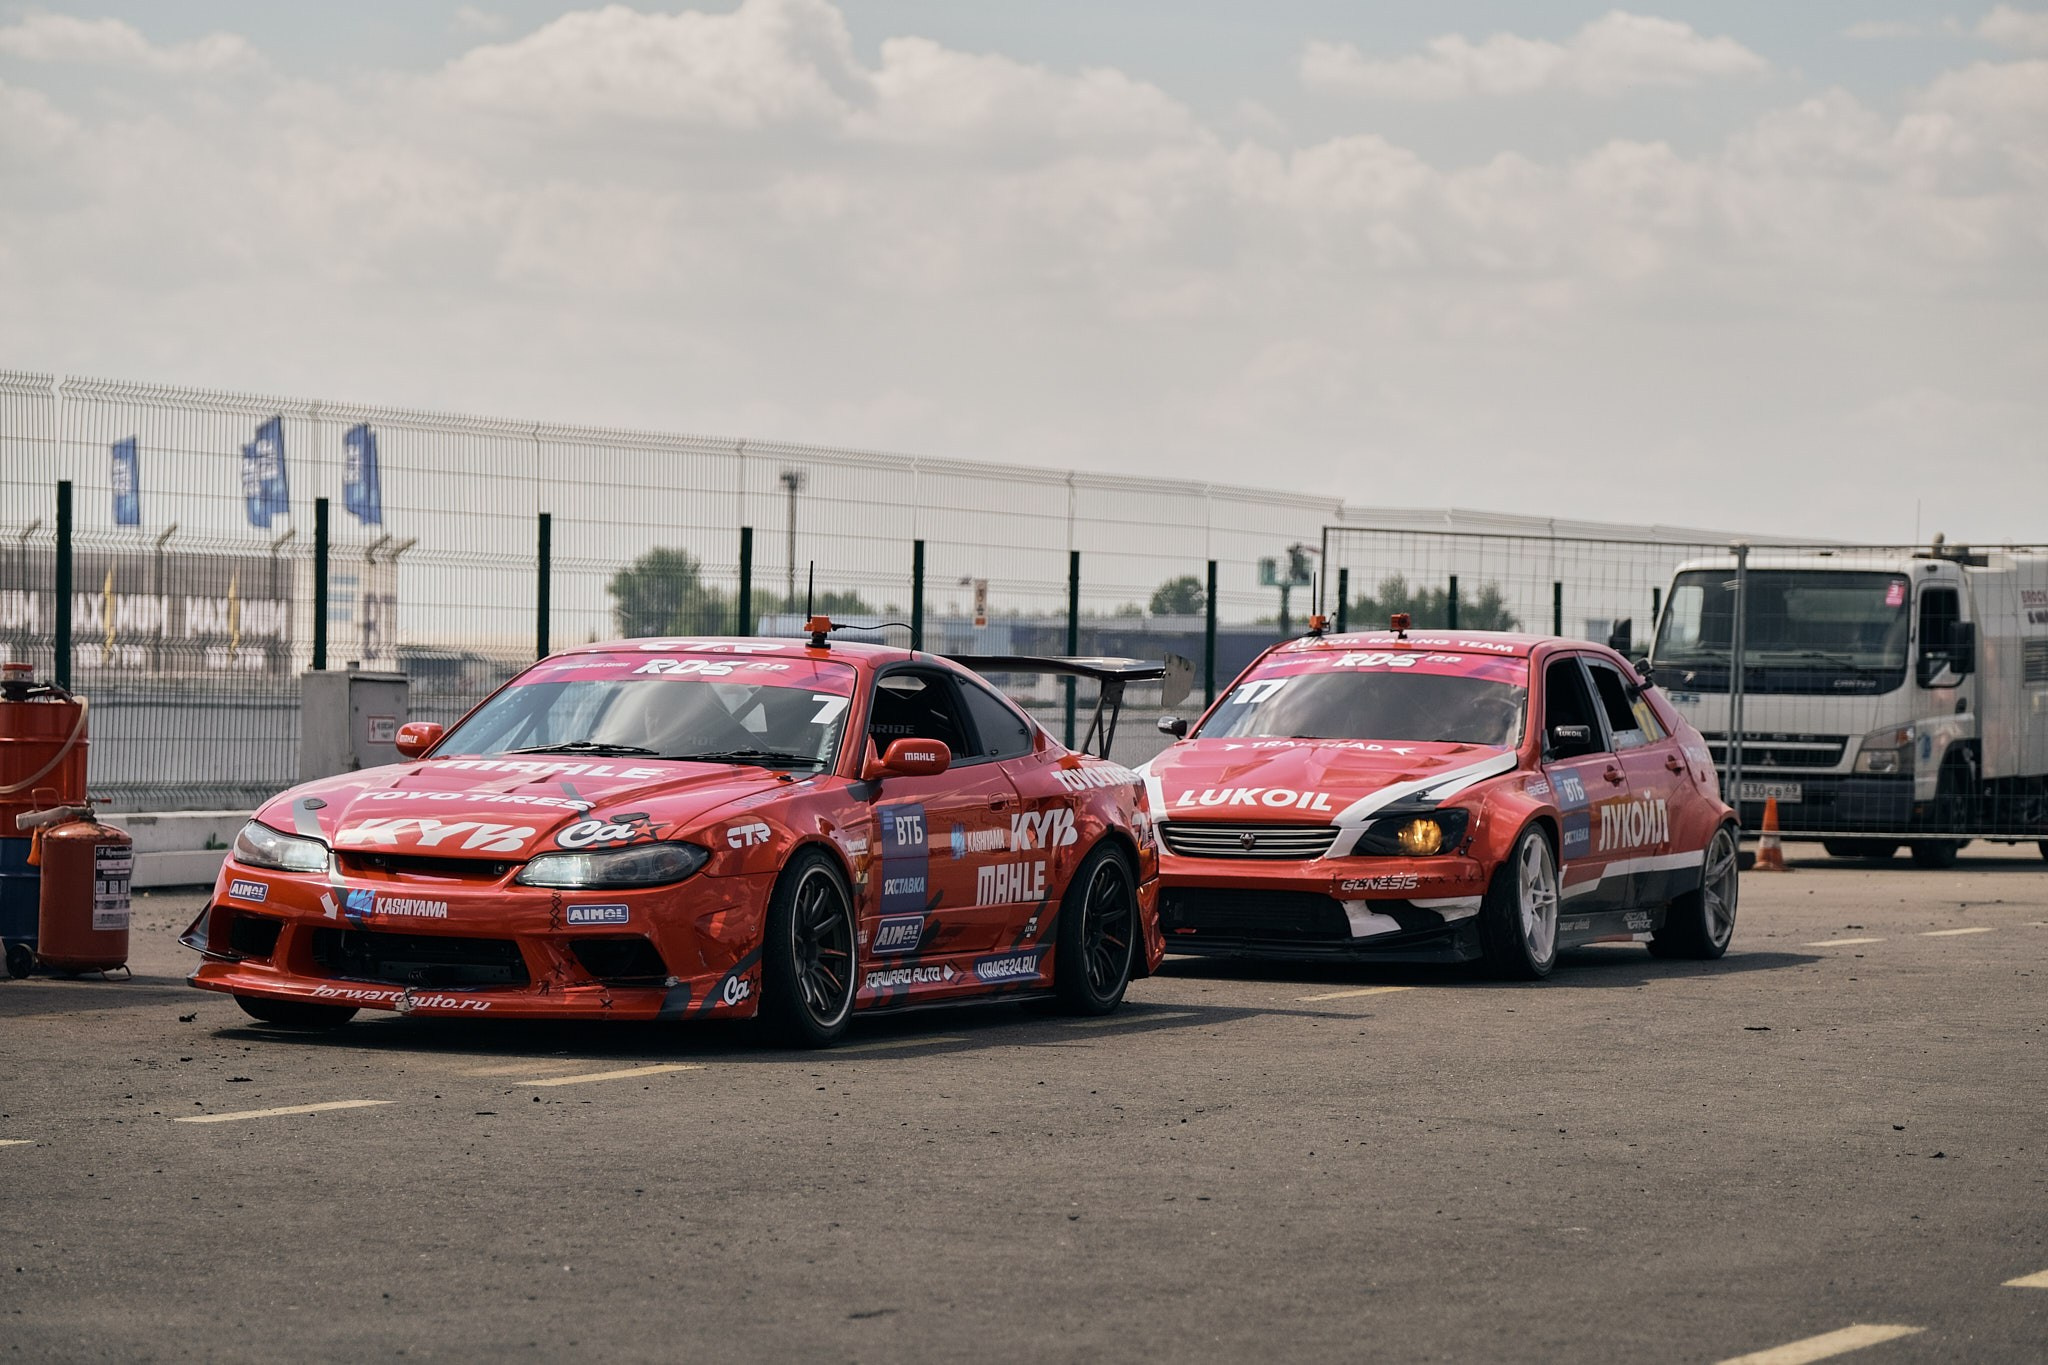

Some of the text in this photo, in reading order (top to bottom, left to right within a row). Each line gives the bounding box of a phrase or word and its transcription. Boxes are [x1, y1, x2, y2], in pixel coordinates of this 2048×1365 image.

[1458, 640, 1515, 653] TEAM
[632, 659, 749, 676] RDS
[1331, 652, 1428, 668] RDS
[1232, 678, 1289, 705] 17
[810, 694, 850, 725] 7
[399, 734, 418, 744] MAHLE
[1558, 730, 1583, 738] LUKOIL
[904, 752, 936, 762] MAHLE
[434, 760, 668, 780] MAHLE
[1050, 767, 1107, 792] TOYO
[357, 791, 598, 812] TOYO TIRES
[1176, 787, 1334, 811] LUKOIL
[1563, 778, 1585, 802] ВТБ
[896, 815, 924, 846] ВТБ
[1010, 807, 1079, 852] KYB
[1599, 789, 1670, 852] ЛУКОЙЛ
[334, 817, 537, 852] KYB
[726, 822, 772, 849] CTR
[967, 829, 1006, 853] KASHIYAMA
[230, 881, 265, 900] AIMOL
[975, 860, 1046, 907] MAHLE
[1341, 872, 1420, 891] GENESIS
[375, 897, 448, 919] KASHIYAMA
[569, 908, 627, 921] AIMOL
[874, 922, 921, 947] AIMOL
[866, 966, 941, 988] FORWARD AUTO
[977, 955, 1037, 979] VIRAGE24.RU
[310, 984, 491, 1011] forwardauto.ru
